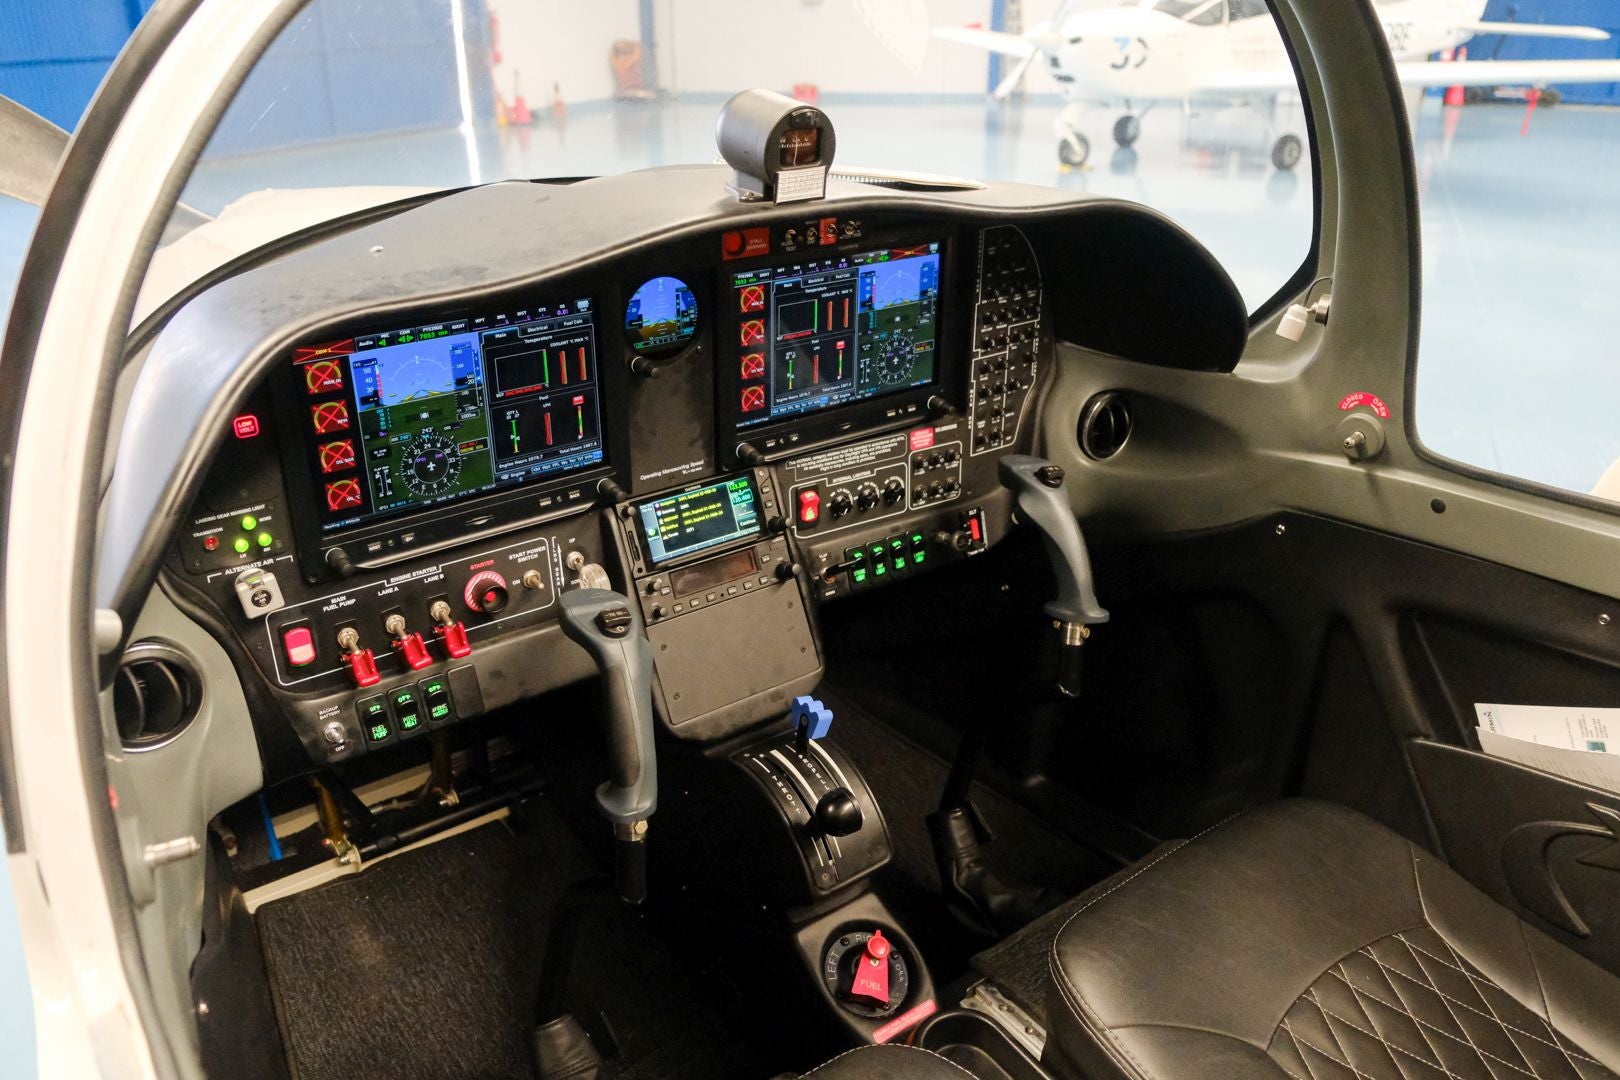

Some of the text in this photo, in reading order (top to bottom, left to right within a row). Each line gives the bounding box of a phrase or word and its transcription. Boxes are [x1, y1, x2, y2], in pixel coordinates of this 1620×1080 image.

[527, 325, 549, 333] Electrical
[524, 335, 553, 344] Temperature
[1341, 394, 1387, 417] CLOSED OPEN
[237, 420, 253, 429] LOW
[499, 461, 514, 469] Engine
[640, 470, 662, 481] Operating
[690, 459, 705, 469] Speed
[195, 515, 217, 525] LANDING
[192, 527, 224, 538] TRANSITION
[508, 545, 546, 561] START POWER
[517, 554, 539, 563] SWITCH
[225, 558, 275, 575] ALTERNATE AIR
[470, 559, 495, 571] STARTER
[390, 566, 438, 584] ENGINE STARTER
[424, 575, 438, 584] LANE
[512, 578, 521, 586] ON
[378, 588, 394, 597] LANE
[331, 595, 347, 604] MAIN
[323, 598, 357, 613] FUEL PUMP
[318, 705, 340, 716] BACKUP
[319, 710, 341, 720] BATTERY
[335, 744, 346, 752] OFF
[827, 951, 840, 980] LEFT
[895, 964, 904, 982] OFF
[860, 979, 882, 992] FUEL
